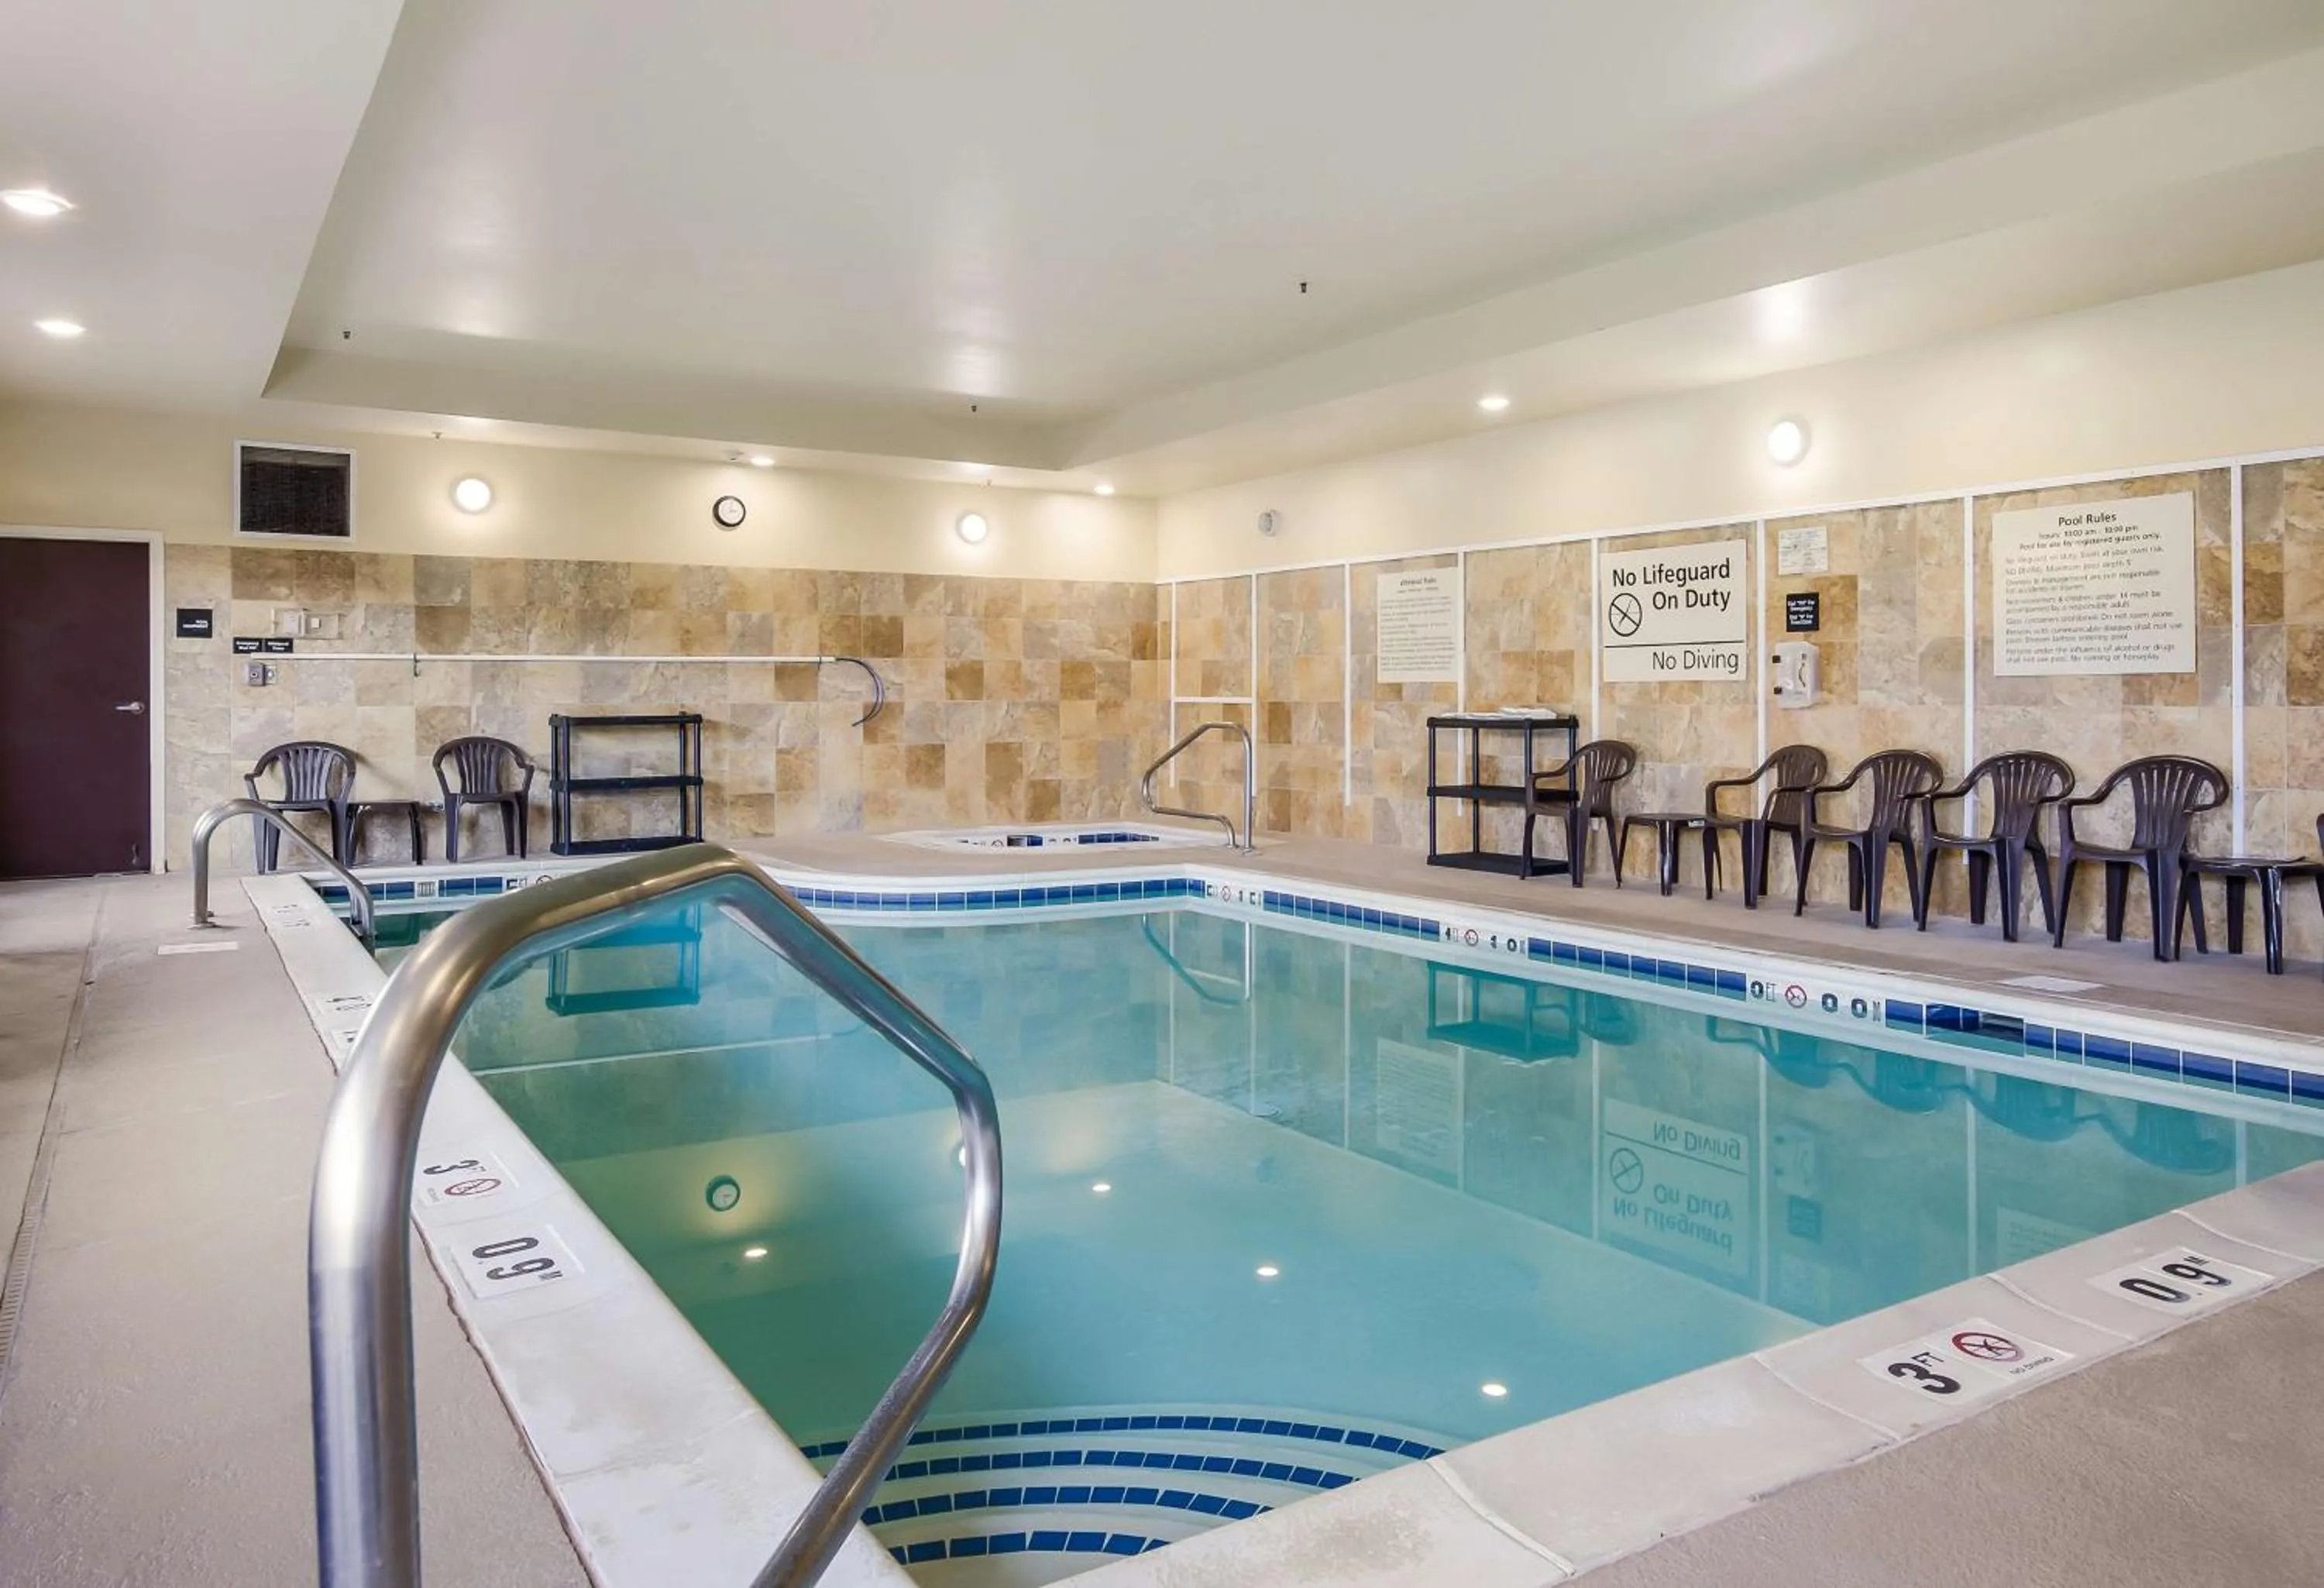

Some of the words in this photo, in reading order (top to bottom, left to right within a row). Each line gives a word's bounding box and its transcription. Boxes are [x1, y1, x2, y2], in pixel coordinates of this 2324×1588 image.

[2058, 515, 2082, 527] Pool
[2086, 513, 2116, 524] Rules
[1612, 568, 1636, 587] No
[1643, 557, 1731, 588] Lifeguard
[1652, 591, 1678, 610] On
[1685, 589, 1731, 612] Duty
[1652, 651, 1676, 670] No
[1683, 648, 1738, 674] Diving
